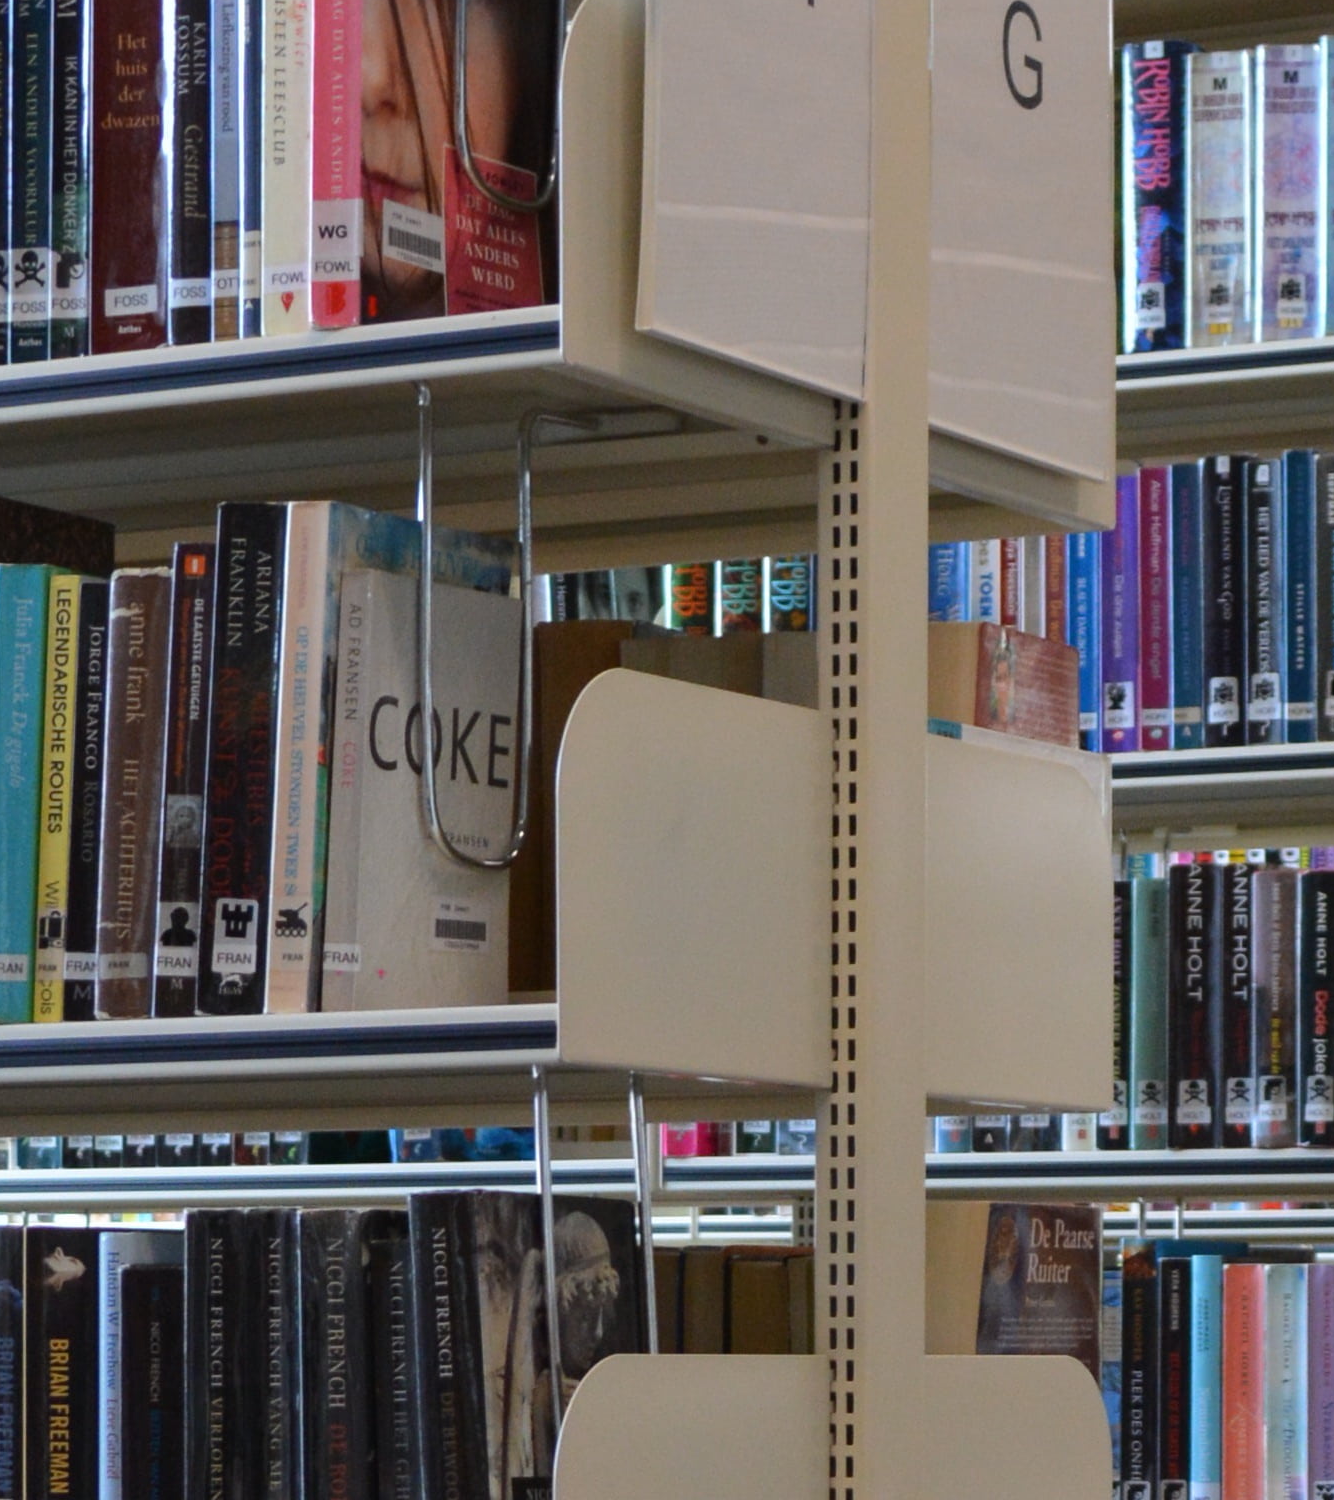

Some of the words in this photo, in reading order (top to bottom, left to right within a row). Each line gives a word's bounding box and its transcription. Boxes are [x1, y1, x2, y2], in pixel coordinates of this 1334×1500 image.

[115, 58, 148, 75] huis
[117, 34, 146, 51] Het
[176, 15, 189, 95] FOSSUM
[193, 22, 206, 84] KARIN
[1003, 0, 1043, 110] G
[118, 84, 146, 103] der
[101, 112, 159, 130] dwazen
[318, 225, 348, 240] WG
[456, 214, 483, 233] DAT
[487, 220, 526, 248] ALLES
[464, 238, 520, 269] ANDERS
[315, 261, 354, 274] FOWL
[472, 264, 515, 292] WERD
[114, 293, 148, 307] FOSS
[228, 537, 246, 648] FRANKLIN
[253, 553, 272, 634] ARIANA
[51, 589, 71, 755] LEGENDARISCHE
[369, 694, 511, 789] COKE
[47, 761, 65, 834] ROUTES
[1187, 864, 1203, 930] ANNE
[1316, 892, 1328, 931] ANNE
[1187, 936, 1203, 1001] HOLT
[1315, 938, 1328, 976] HOLT
[1031, 1218, 1052, 1248] De
[1054, 1219, 1095, 1250] Paarse
[210, 1238, 223, 1298] NICCI
[1026, 1252, 1071, 1284] Ruiter
[49, 1338, 69, 1395] BRIAN
[210, 1305, 223, 1390] FRENCH
[49, 1400, 69, 1495] FREEMAN
